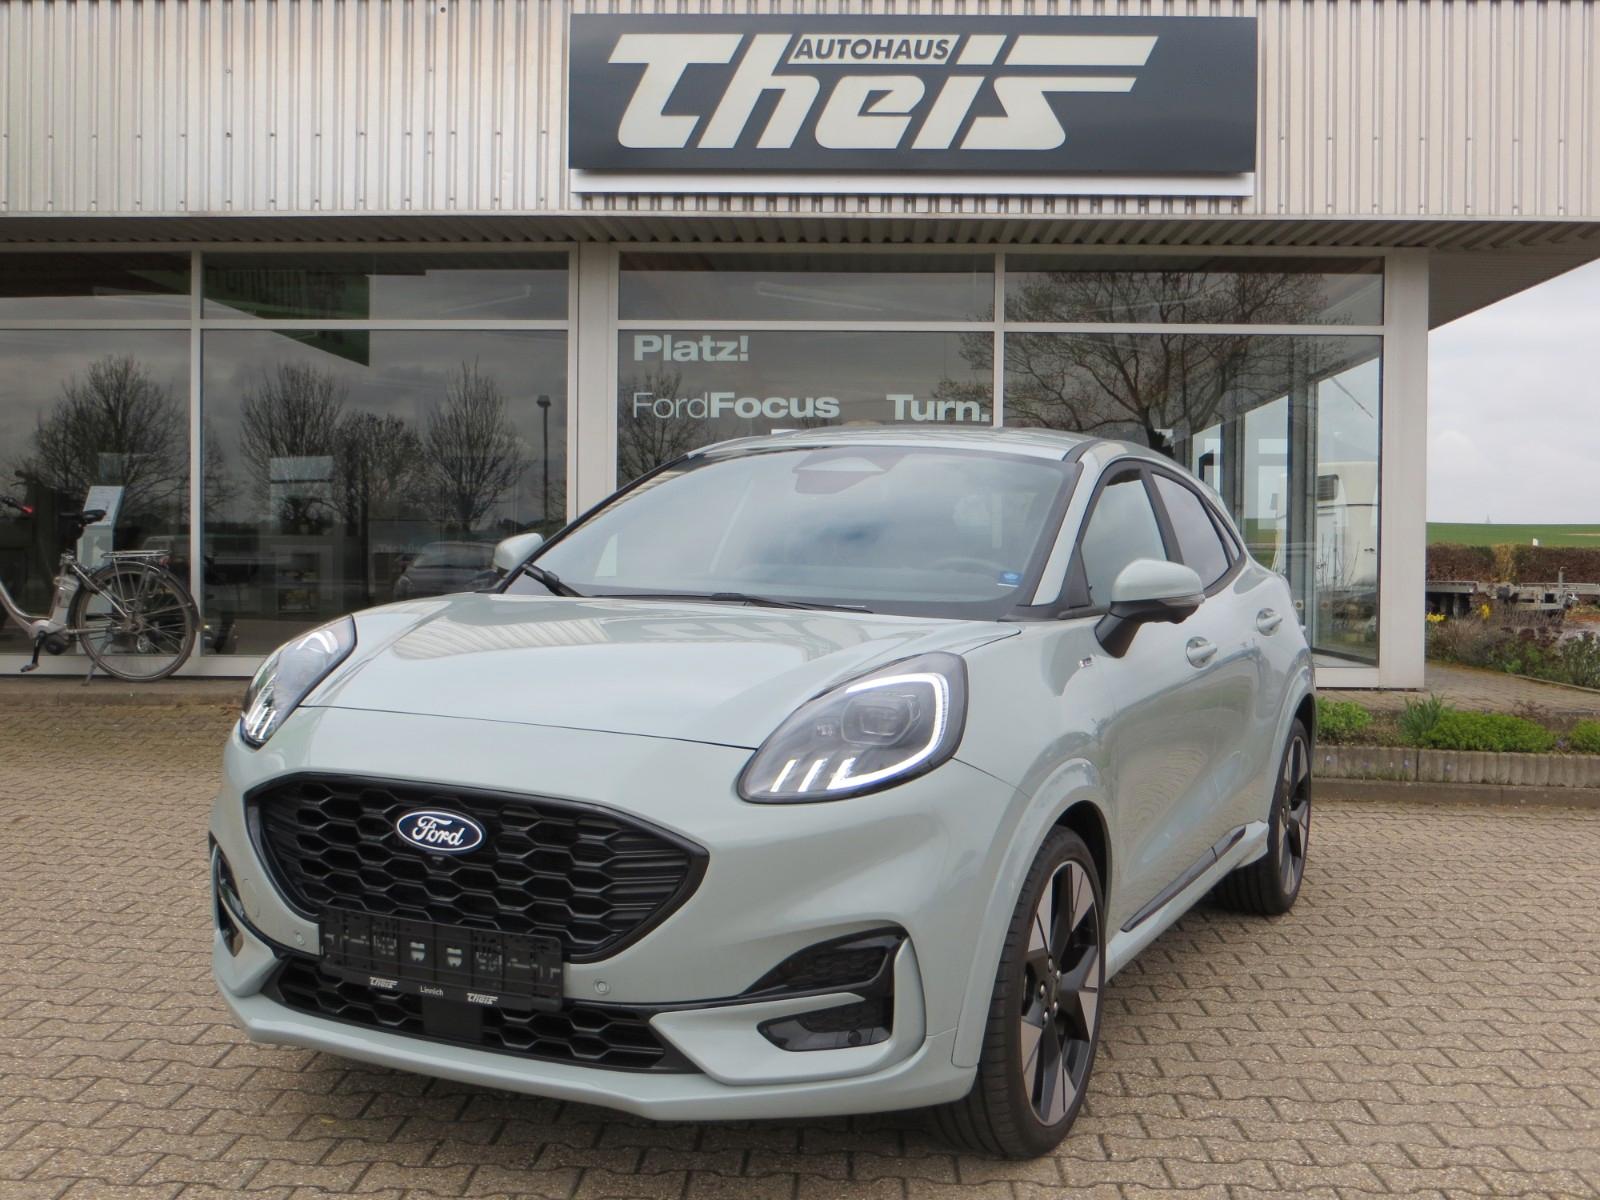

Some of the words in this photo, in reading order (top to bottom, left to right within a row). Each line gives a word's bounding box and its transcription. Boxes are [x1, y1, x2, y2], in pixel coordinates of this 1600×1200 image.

[794, 38, 950, 60] AUTOHAUS
[607, 33, 1159, 151] Theis
[633, 334, 750, 362] Platz!
[886, 393, 991, 423] Turn.
[411, 815, 466, 846] Ford
